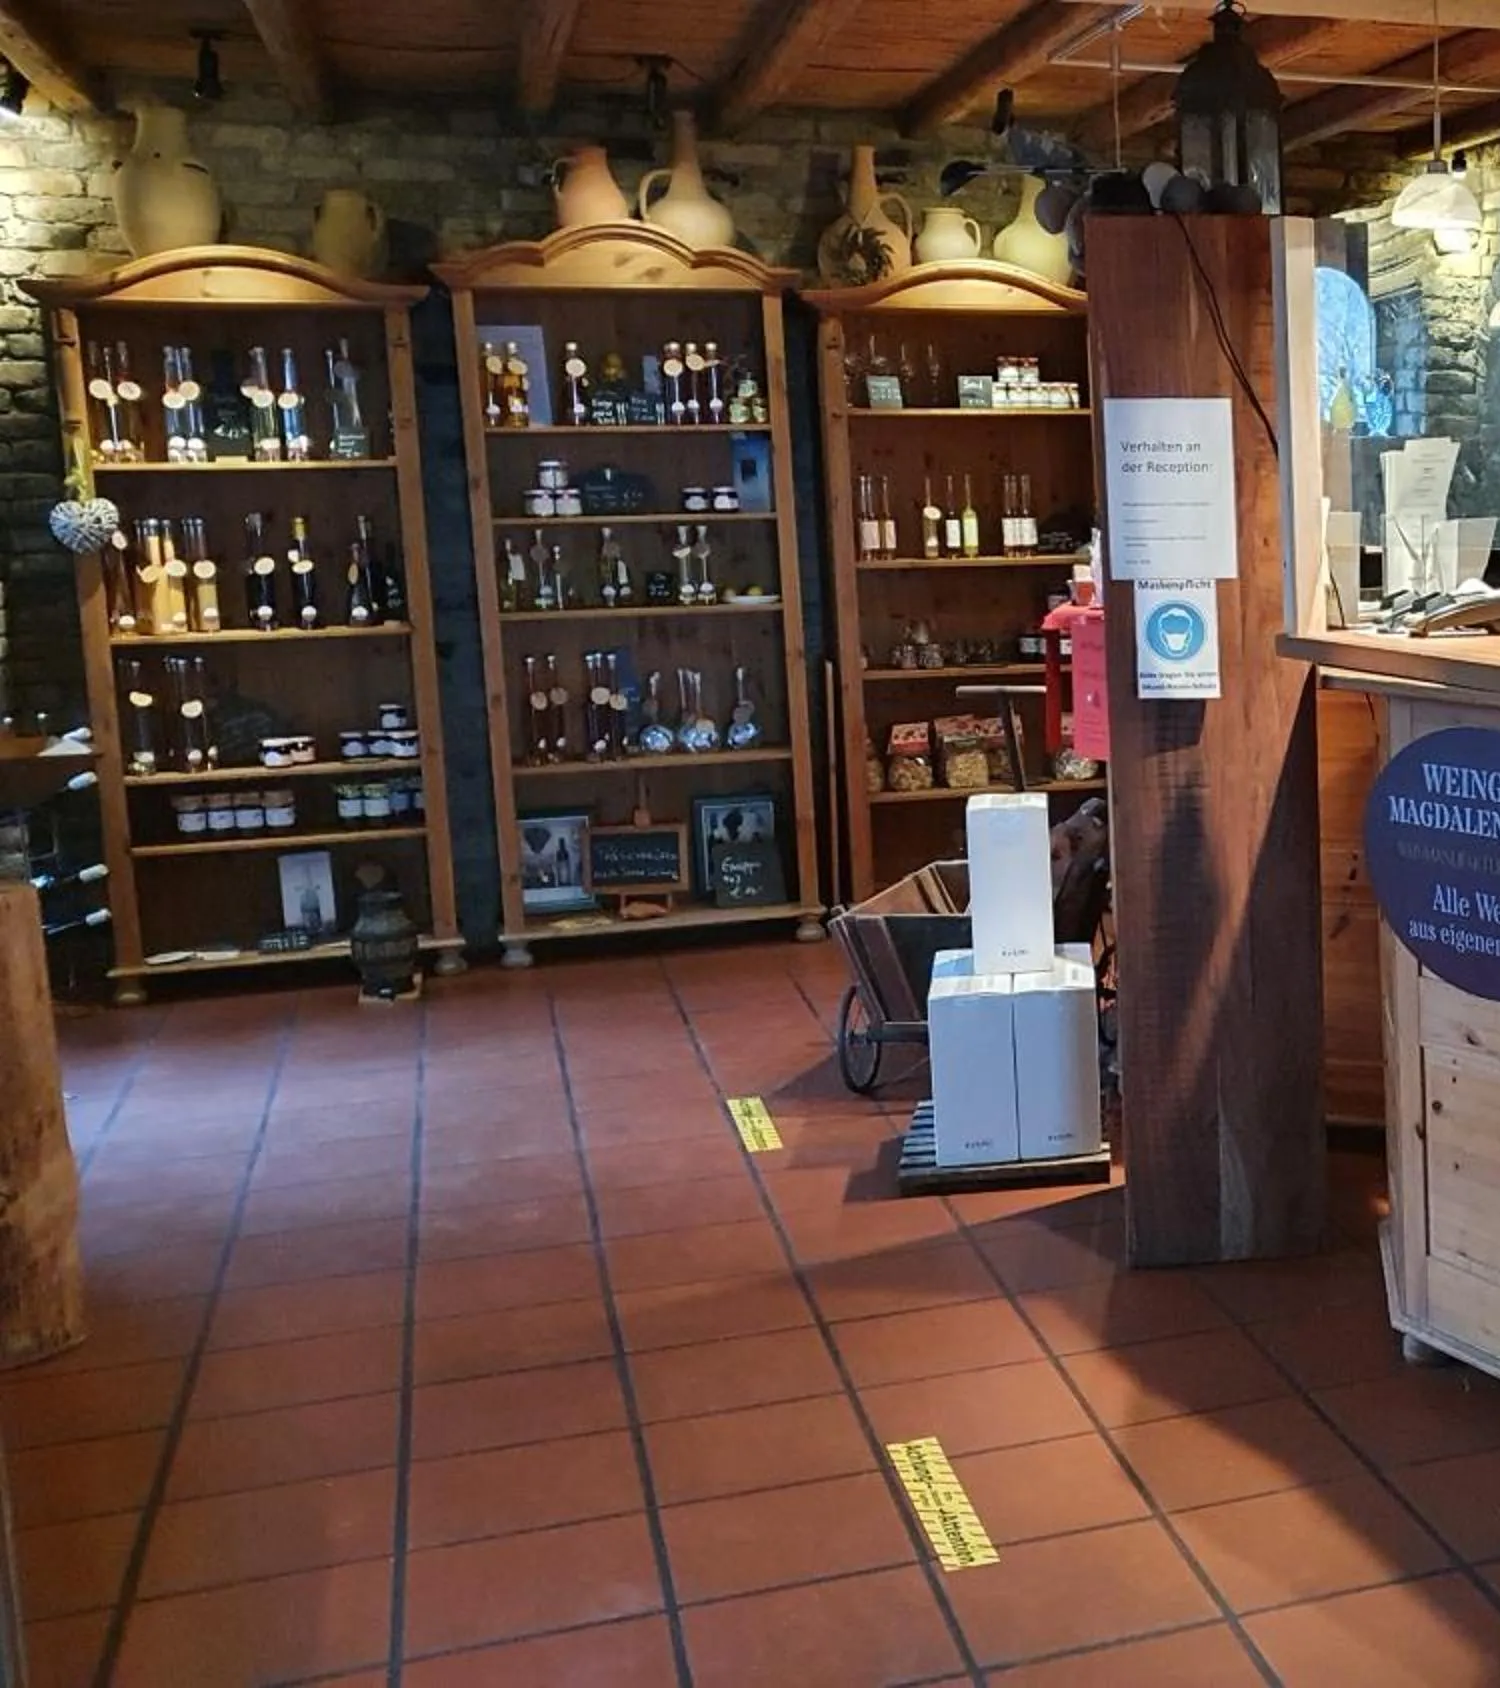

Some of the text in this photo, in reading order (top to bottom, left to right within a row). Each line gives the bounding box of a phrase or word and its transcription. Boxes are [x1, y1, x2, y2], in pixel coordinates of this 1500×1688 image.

[1120, 440, 1201, 454] Verhalten an
[1121, 461, 1142, 473] der
[1138, 579, 1212, 592] Maskenpflicht
[1432, 883, 1471, 918] Alle
[1408, 918, 1436, 942] aus
